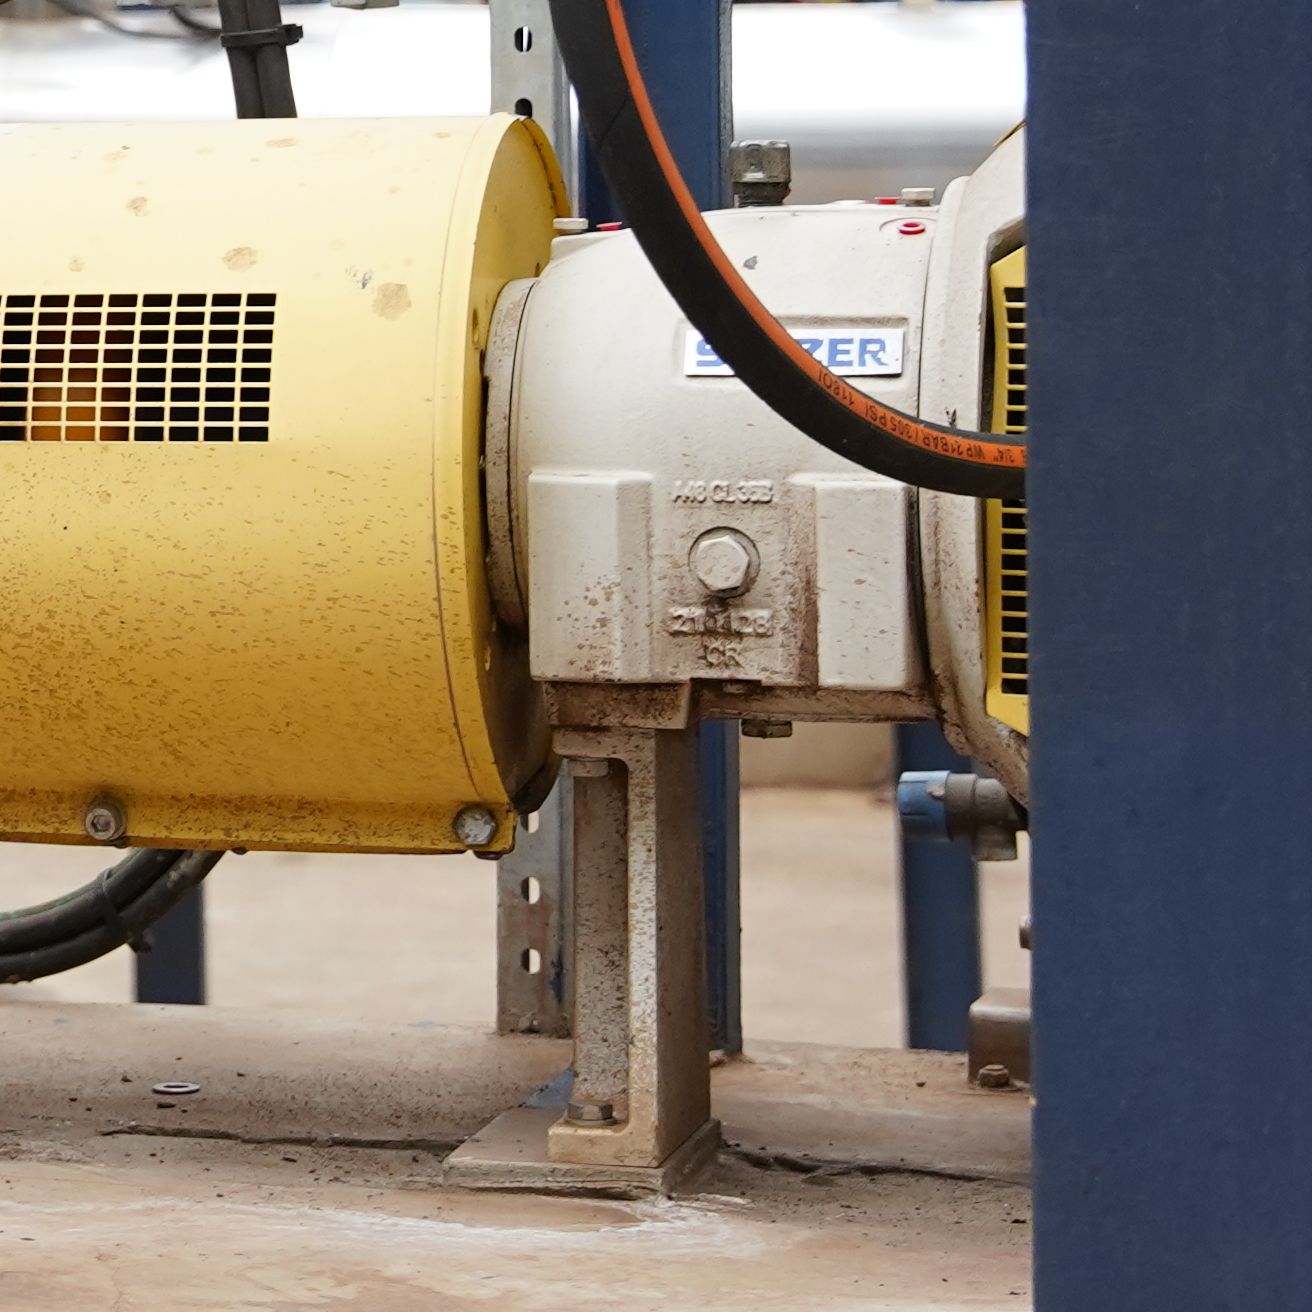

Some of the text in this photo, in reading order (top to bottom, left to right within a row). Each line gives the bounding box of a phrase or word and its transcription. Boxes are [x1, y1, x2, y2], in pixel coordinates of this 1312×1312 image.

[695, 338, 889, 367] SZER
[864, 401, 888, 427] PSI
[889, 416, 913, 438] 305
[966, 442, 986, 461] WP
